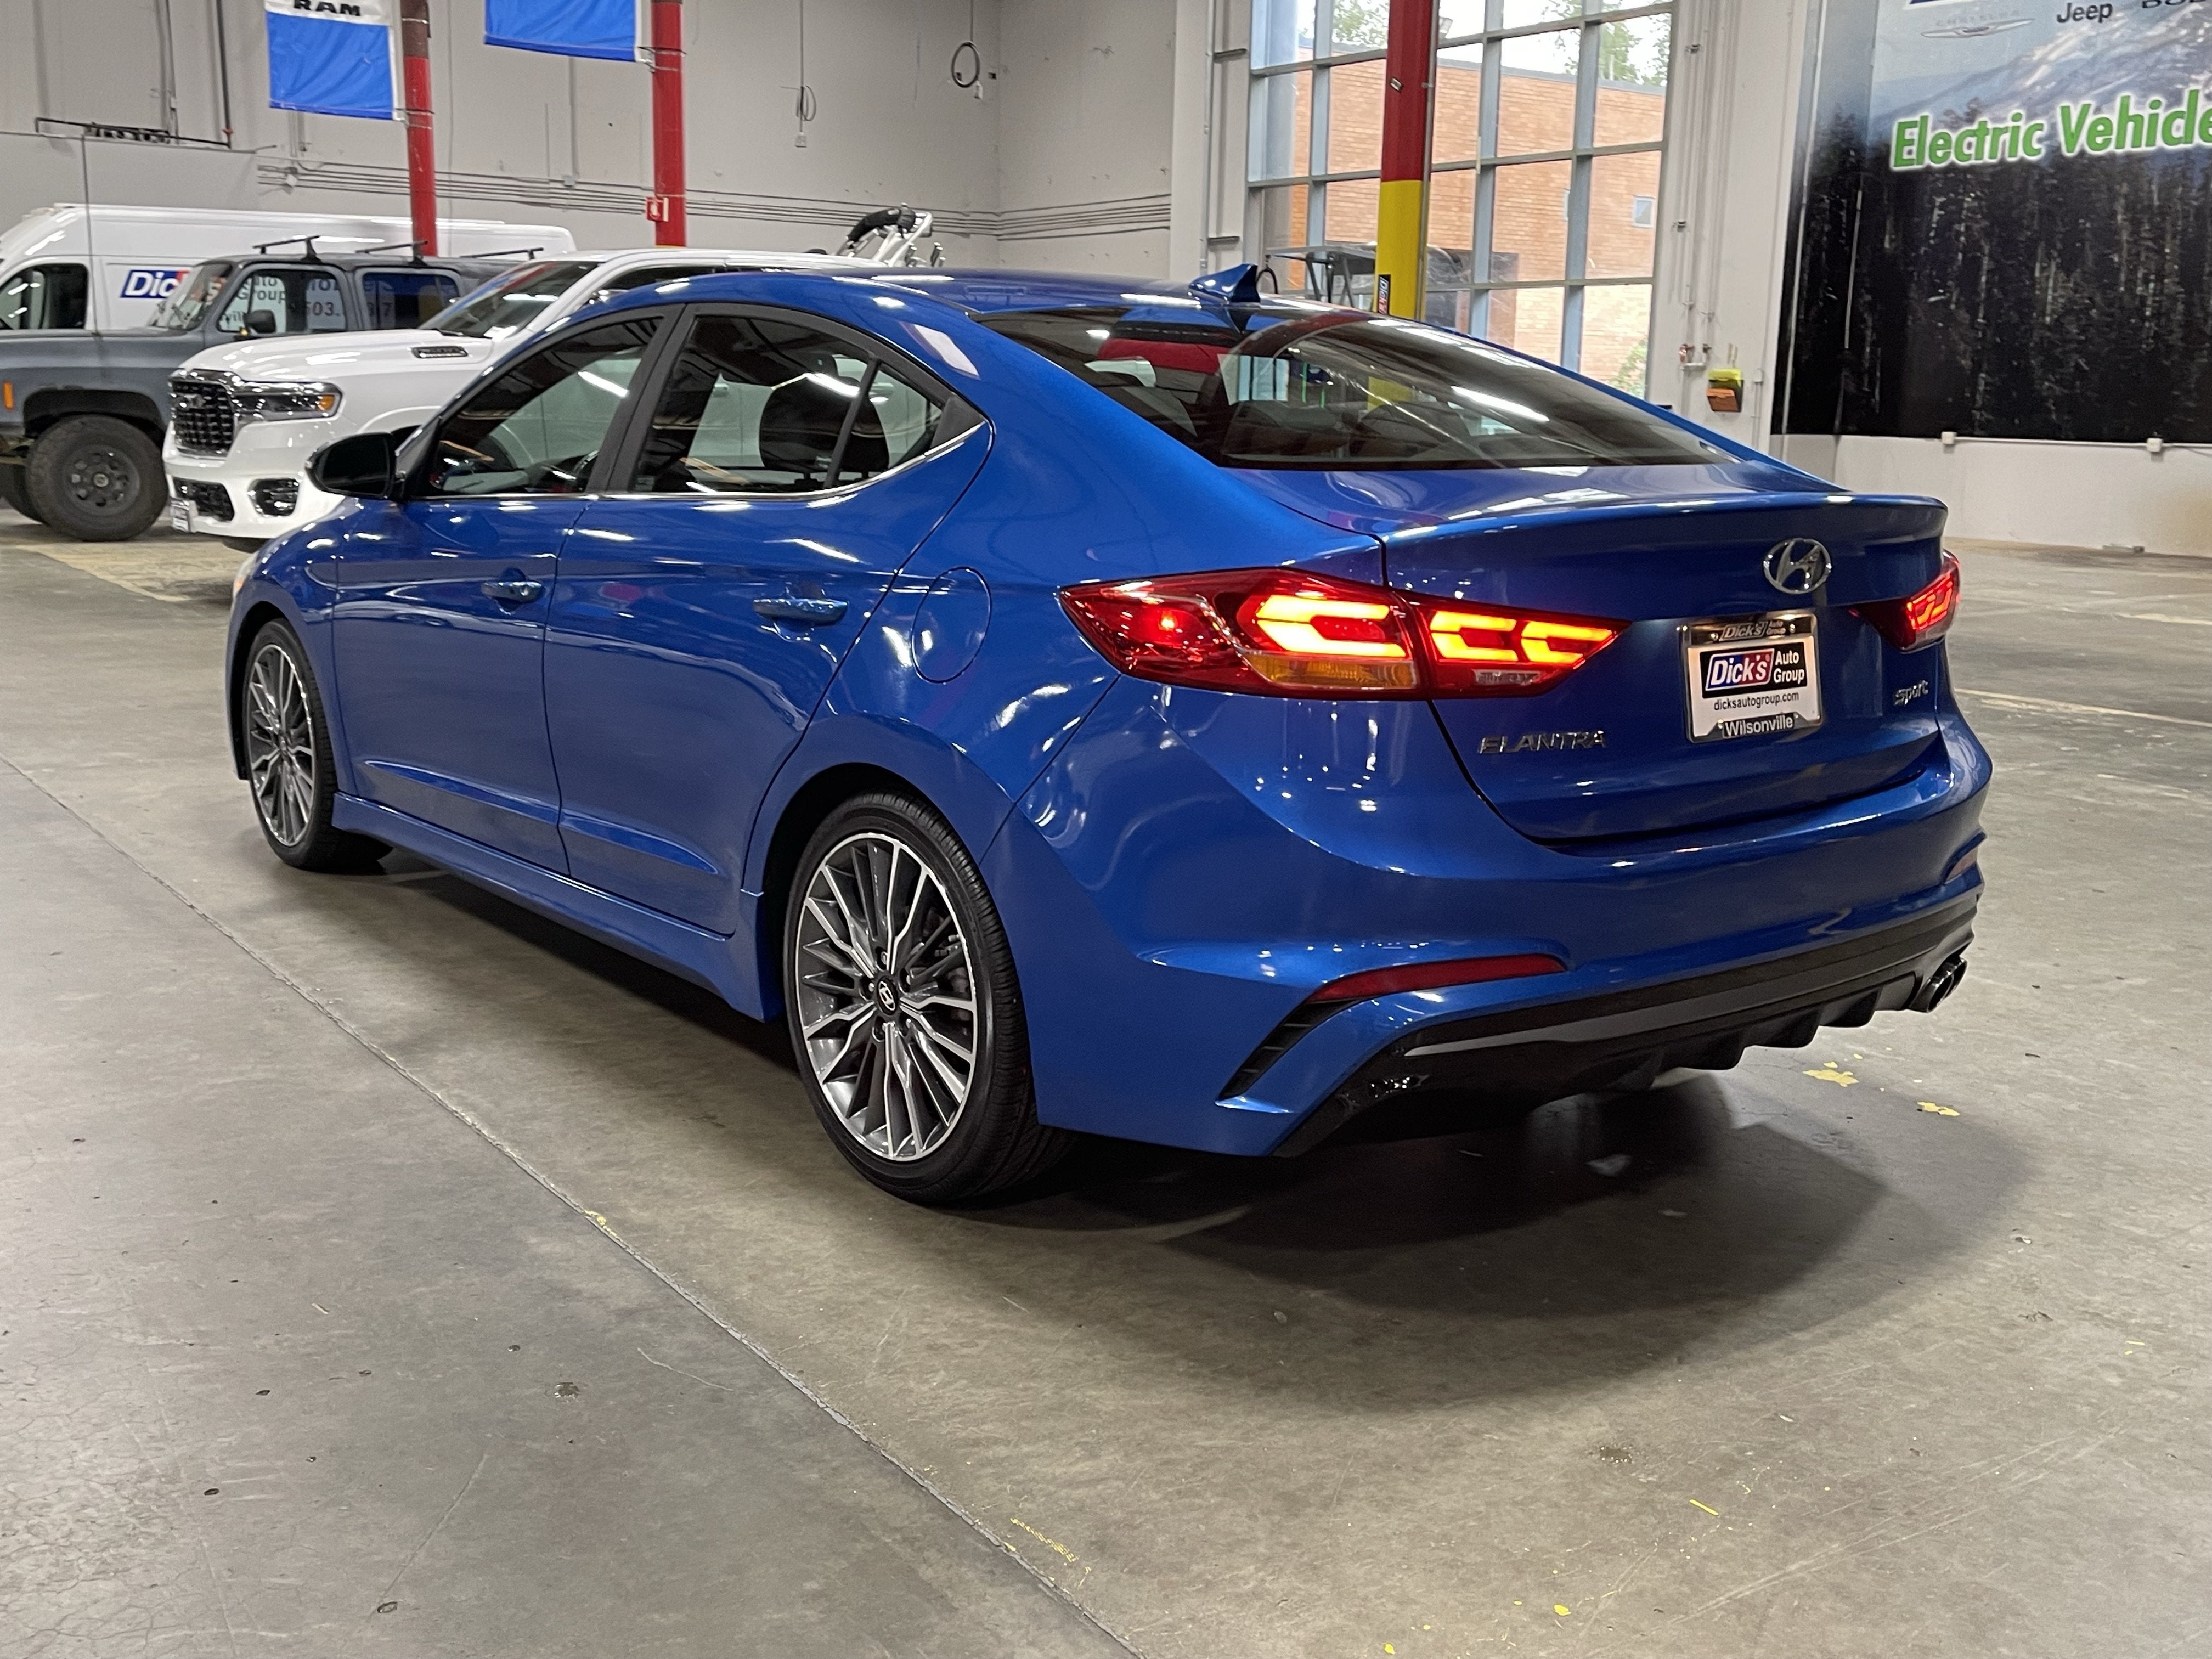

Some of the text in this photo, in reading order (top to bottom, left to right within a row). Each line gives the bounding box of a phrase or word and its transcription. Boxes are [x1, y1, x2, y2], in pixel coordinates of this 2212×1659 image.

[294, 0, 360, 16] RAM
[2057, 2, 2113, 23] Jeep
[1893, 111, 2045, 168] Electric
[1775, 650, 1799, 666] Auto
[1710, 654, 1768, 686] Dick's
[1773, 668, 1805, 685] Group
[1713, 692, 1799, 710] dicksautogroup.com
[1725, 715, 1793, 736] Wilsonville
[1479, 730, 1606, 754] ELANTRA
